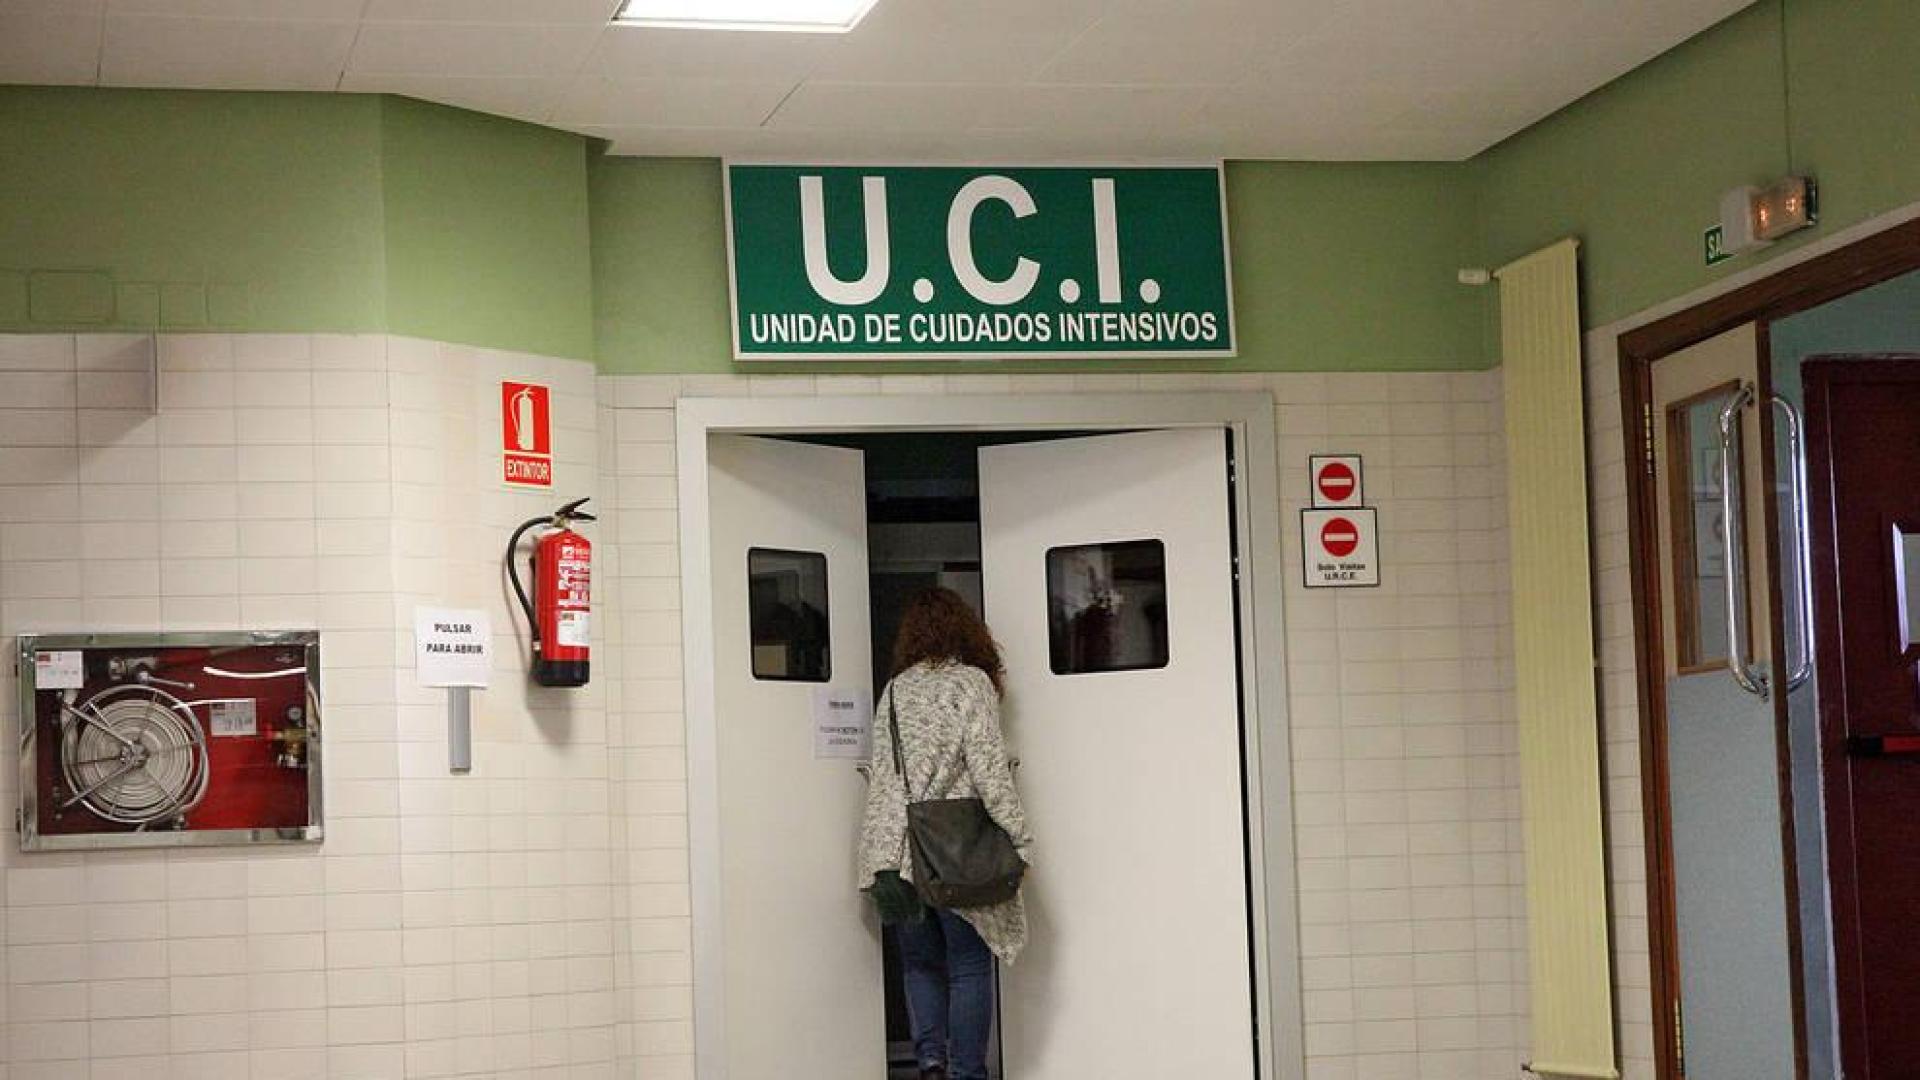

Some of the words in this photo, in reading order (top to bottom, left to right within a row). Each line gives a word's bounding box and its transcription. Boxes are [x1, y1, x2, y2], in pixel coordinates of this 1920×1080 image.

[799, 175, 1161, 305] U.C.I.
[751, 313, 855, 343] UNIDAD
[866, 313, 901, 341] DE
[909, 312, 1051, 342] CUIDADOS
[1060, 311, 1217, 341] INTENSIVOS
[507, 459, 549, 480] EXTINTOR
[433, 623, 472, 633] PULSAR
[426, 643, 451, 653] PARA
[454, 644, 484, 655] ABRIR
